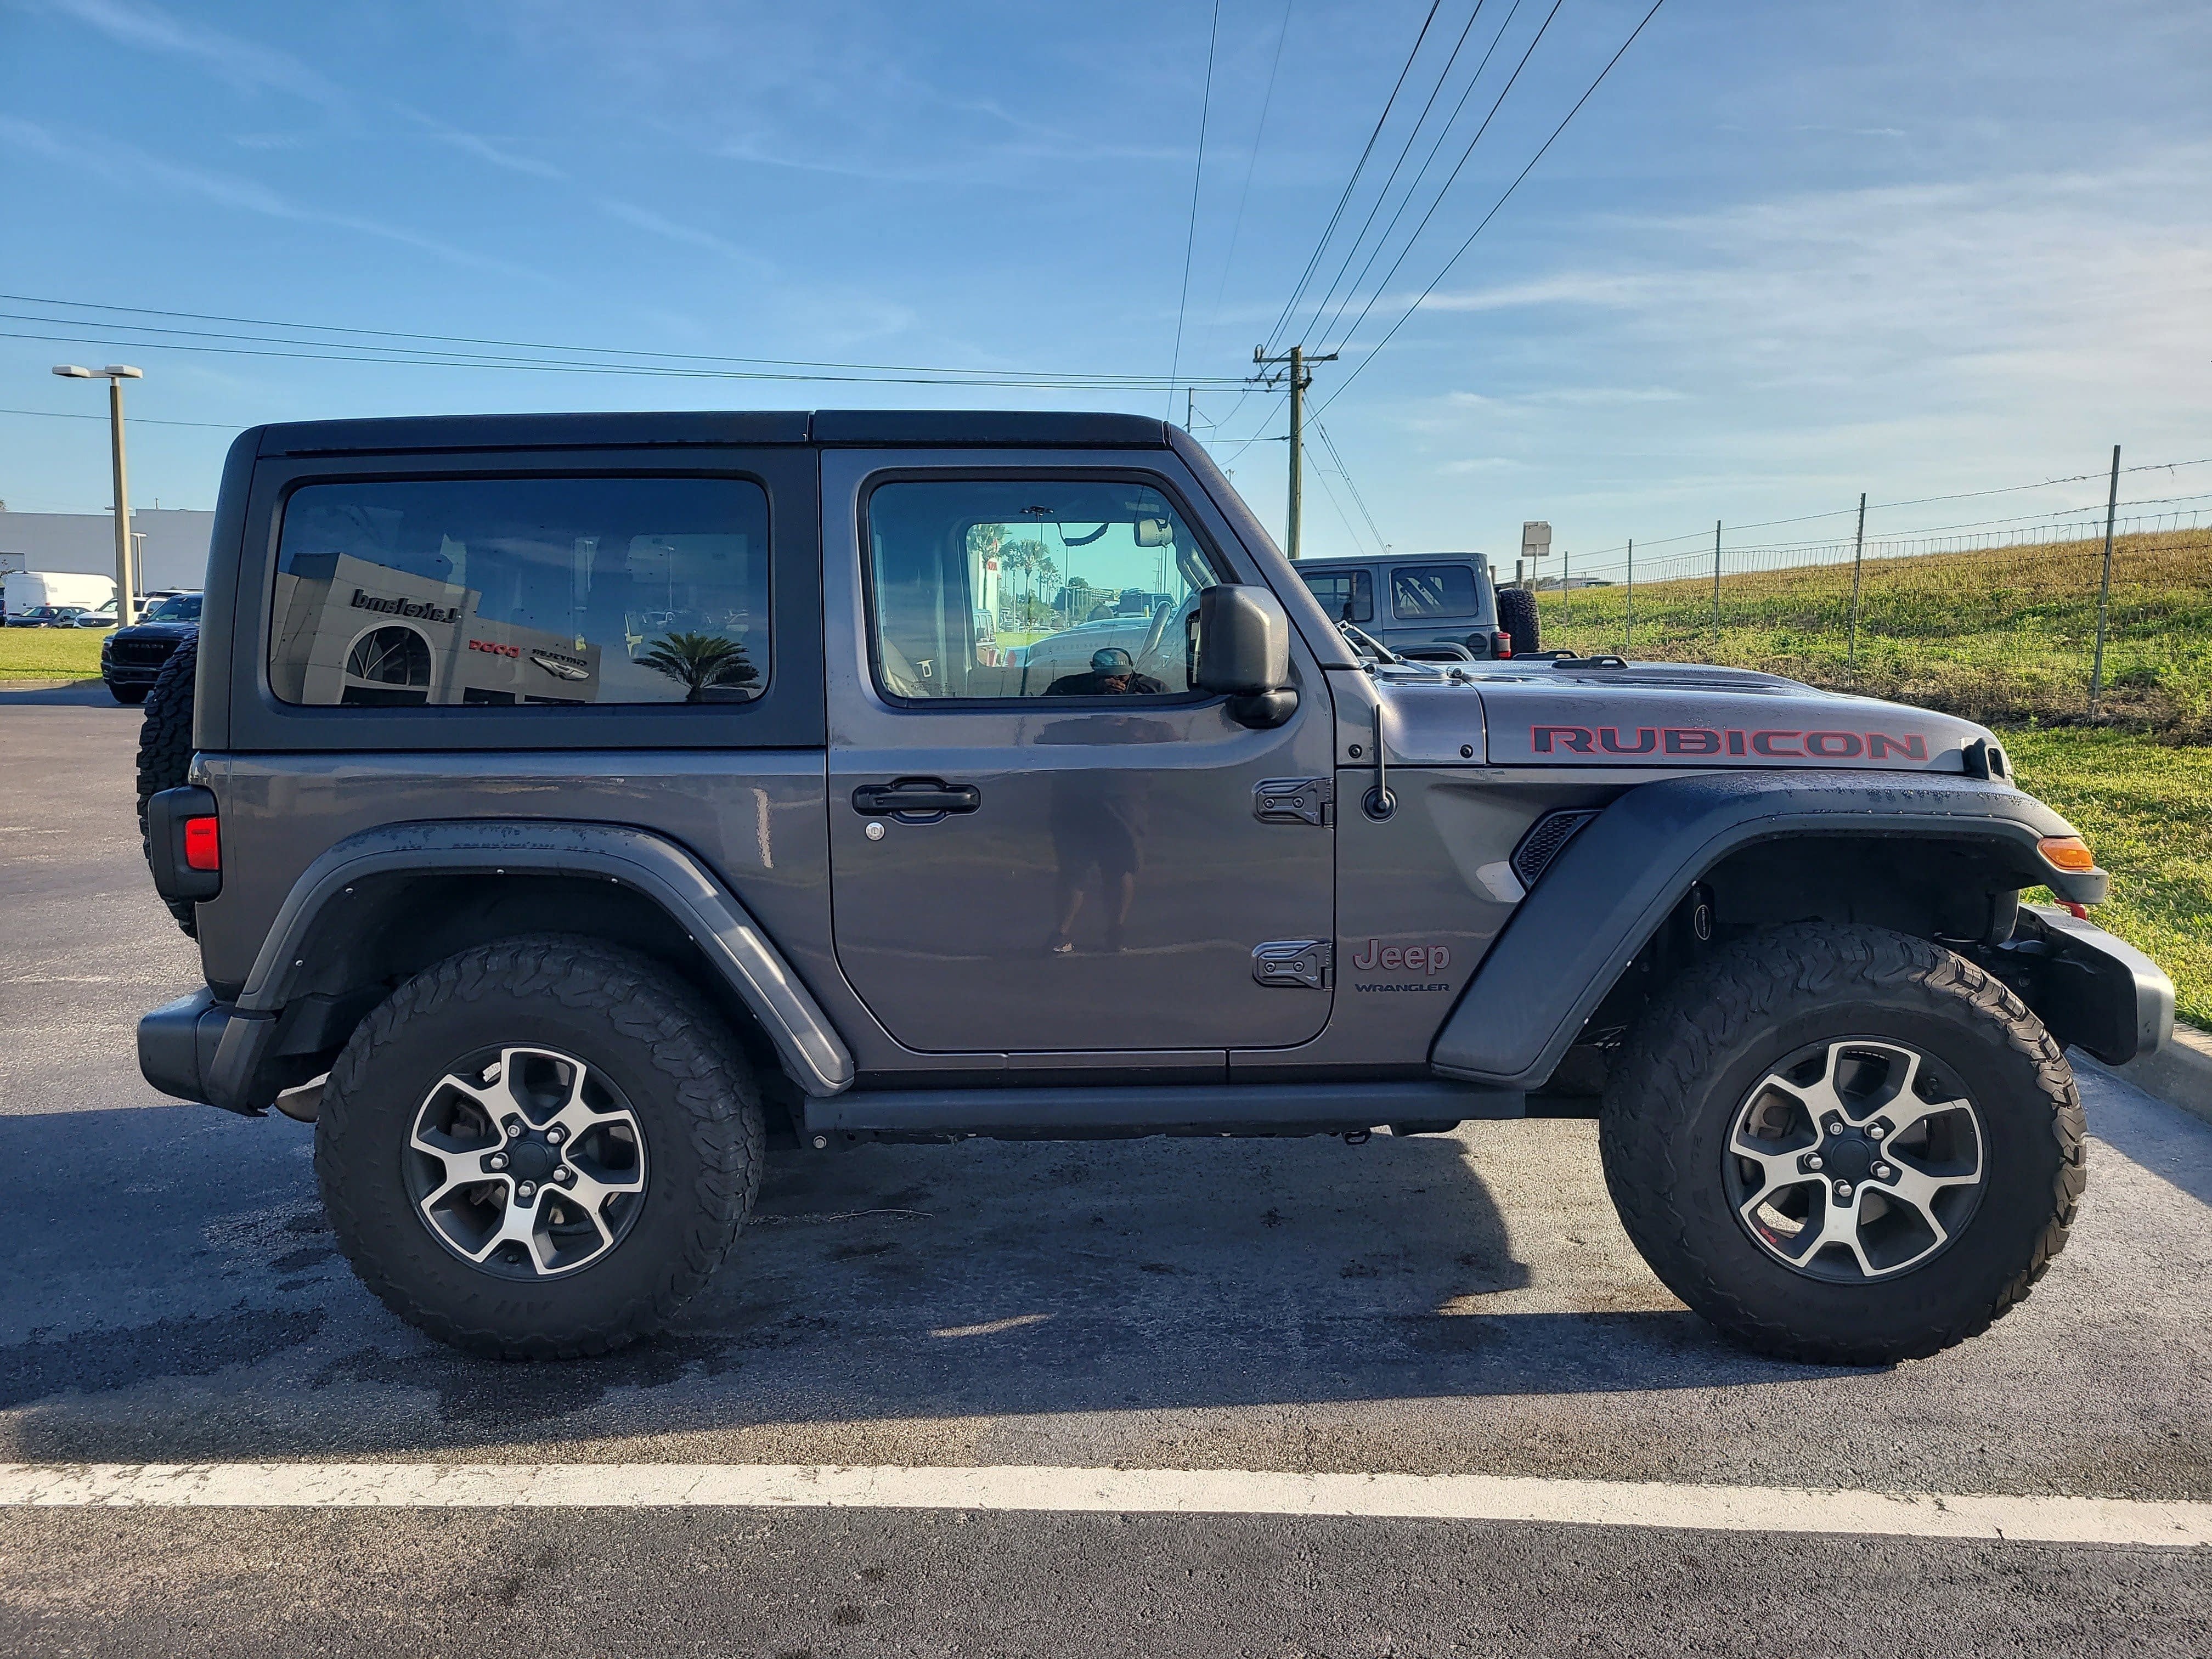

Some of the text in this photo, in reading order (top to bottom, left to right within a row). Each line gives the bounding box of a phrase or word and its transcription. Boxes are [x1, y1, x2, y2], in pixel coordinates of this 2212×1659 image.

[1530, 725, 1929, 761] RUBICON
[1353, 939, 1451, 975] Jeep
[1355, 983, 1451, 992] WRANGLER
